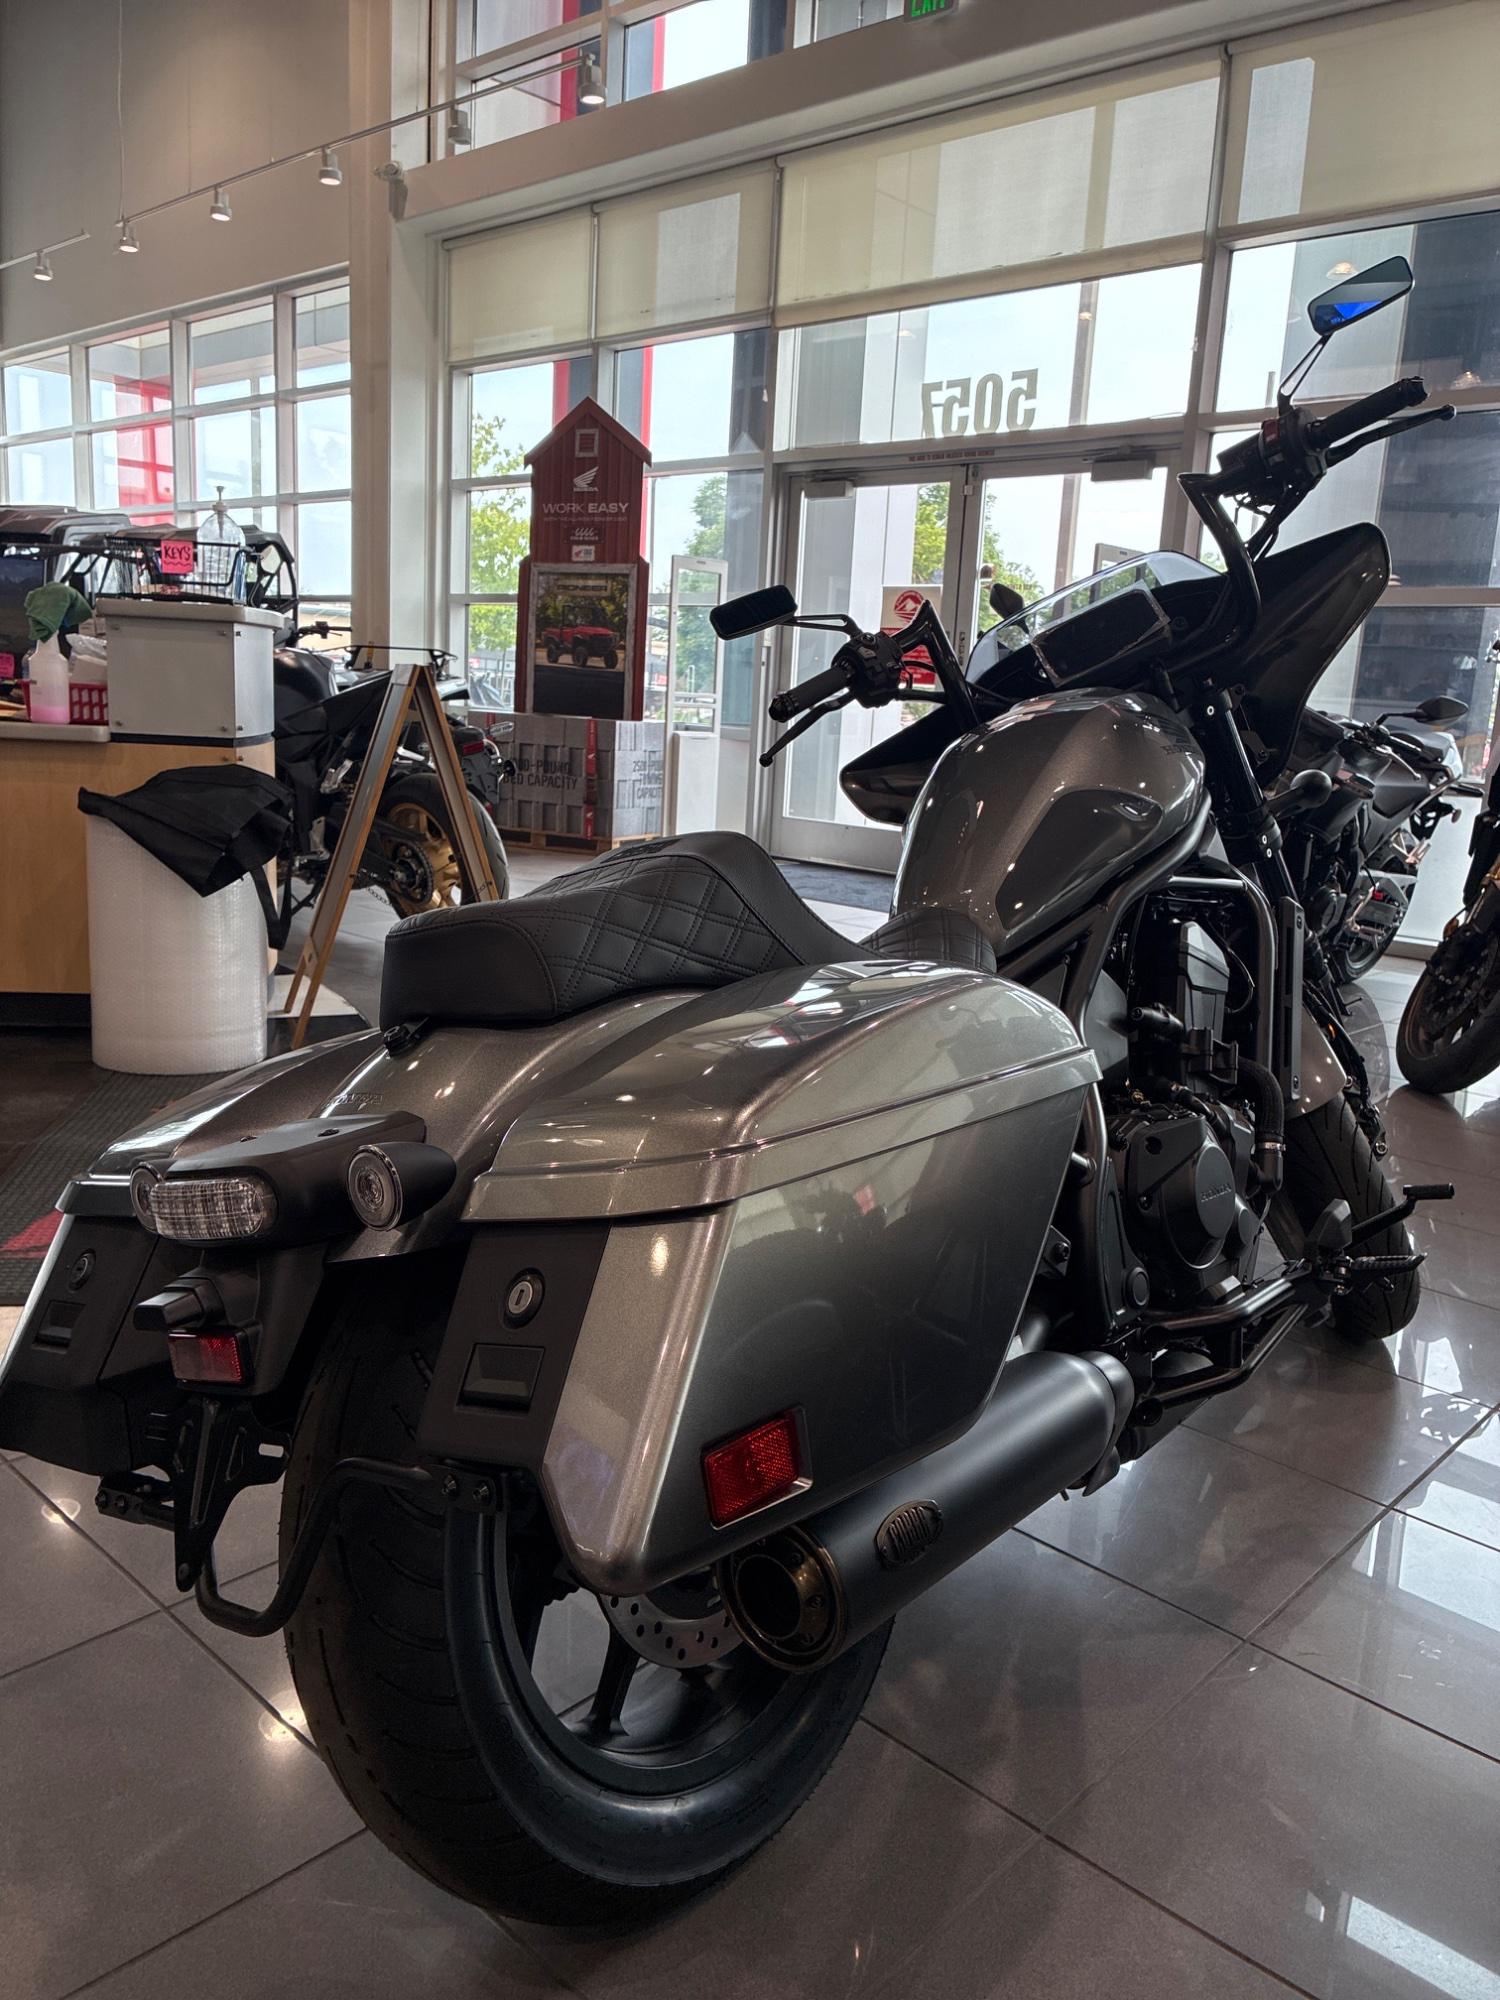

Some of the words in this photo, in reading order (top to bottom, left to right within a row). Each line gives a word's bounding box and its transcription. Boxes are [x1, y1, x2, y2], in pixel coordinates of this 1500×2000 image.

[542, 503, 585, 514] WORK
[587, 502, 629, 514] EASY
[163, 545, 191, 562] KEYS
[527, 773, 578, 790] CAPACITY
[636, 786, 663, 800] CAPACIT
